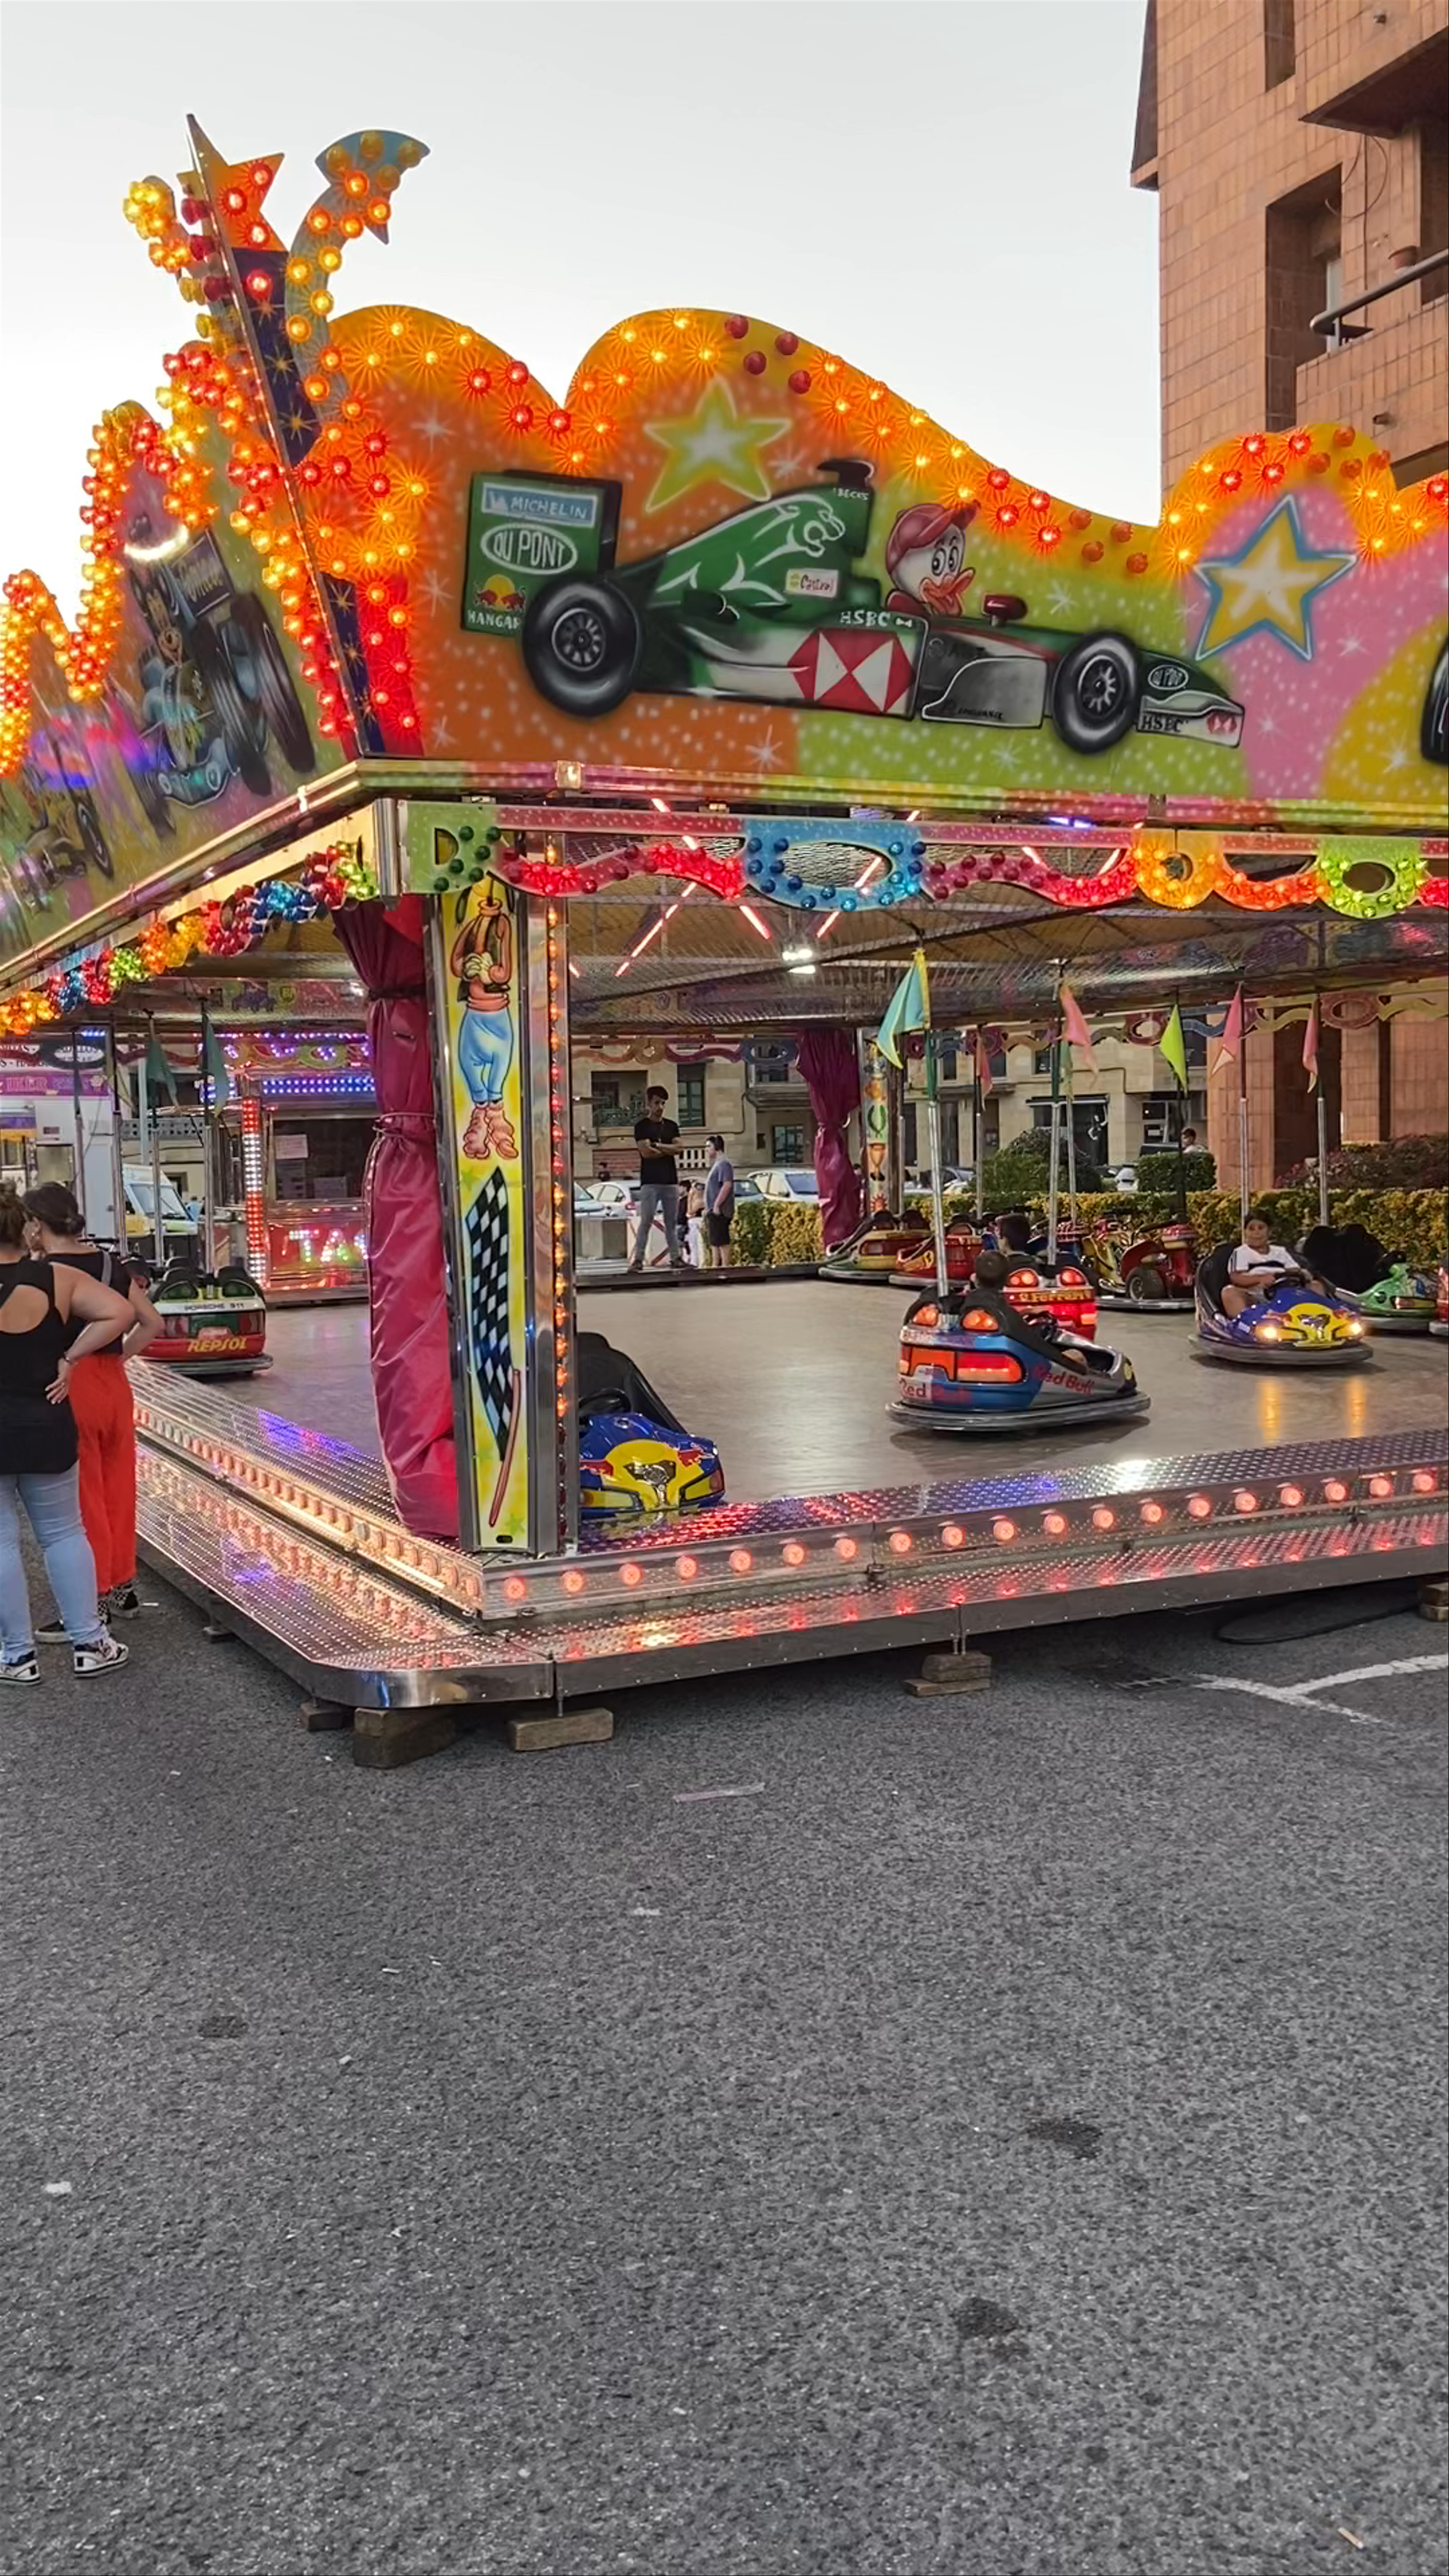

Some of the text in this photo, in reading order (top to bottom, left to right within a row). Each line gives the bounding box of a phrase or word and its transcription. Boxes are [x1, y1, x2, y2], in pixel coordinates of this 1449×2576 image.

[511, 497, 587, 519] MICHELIN
[517, 529, 565, 568] PONT
[840, 609, 891, 627] HSBC
